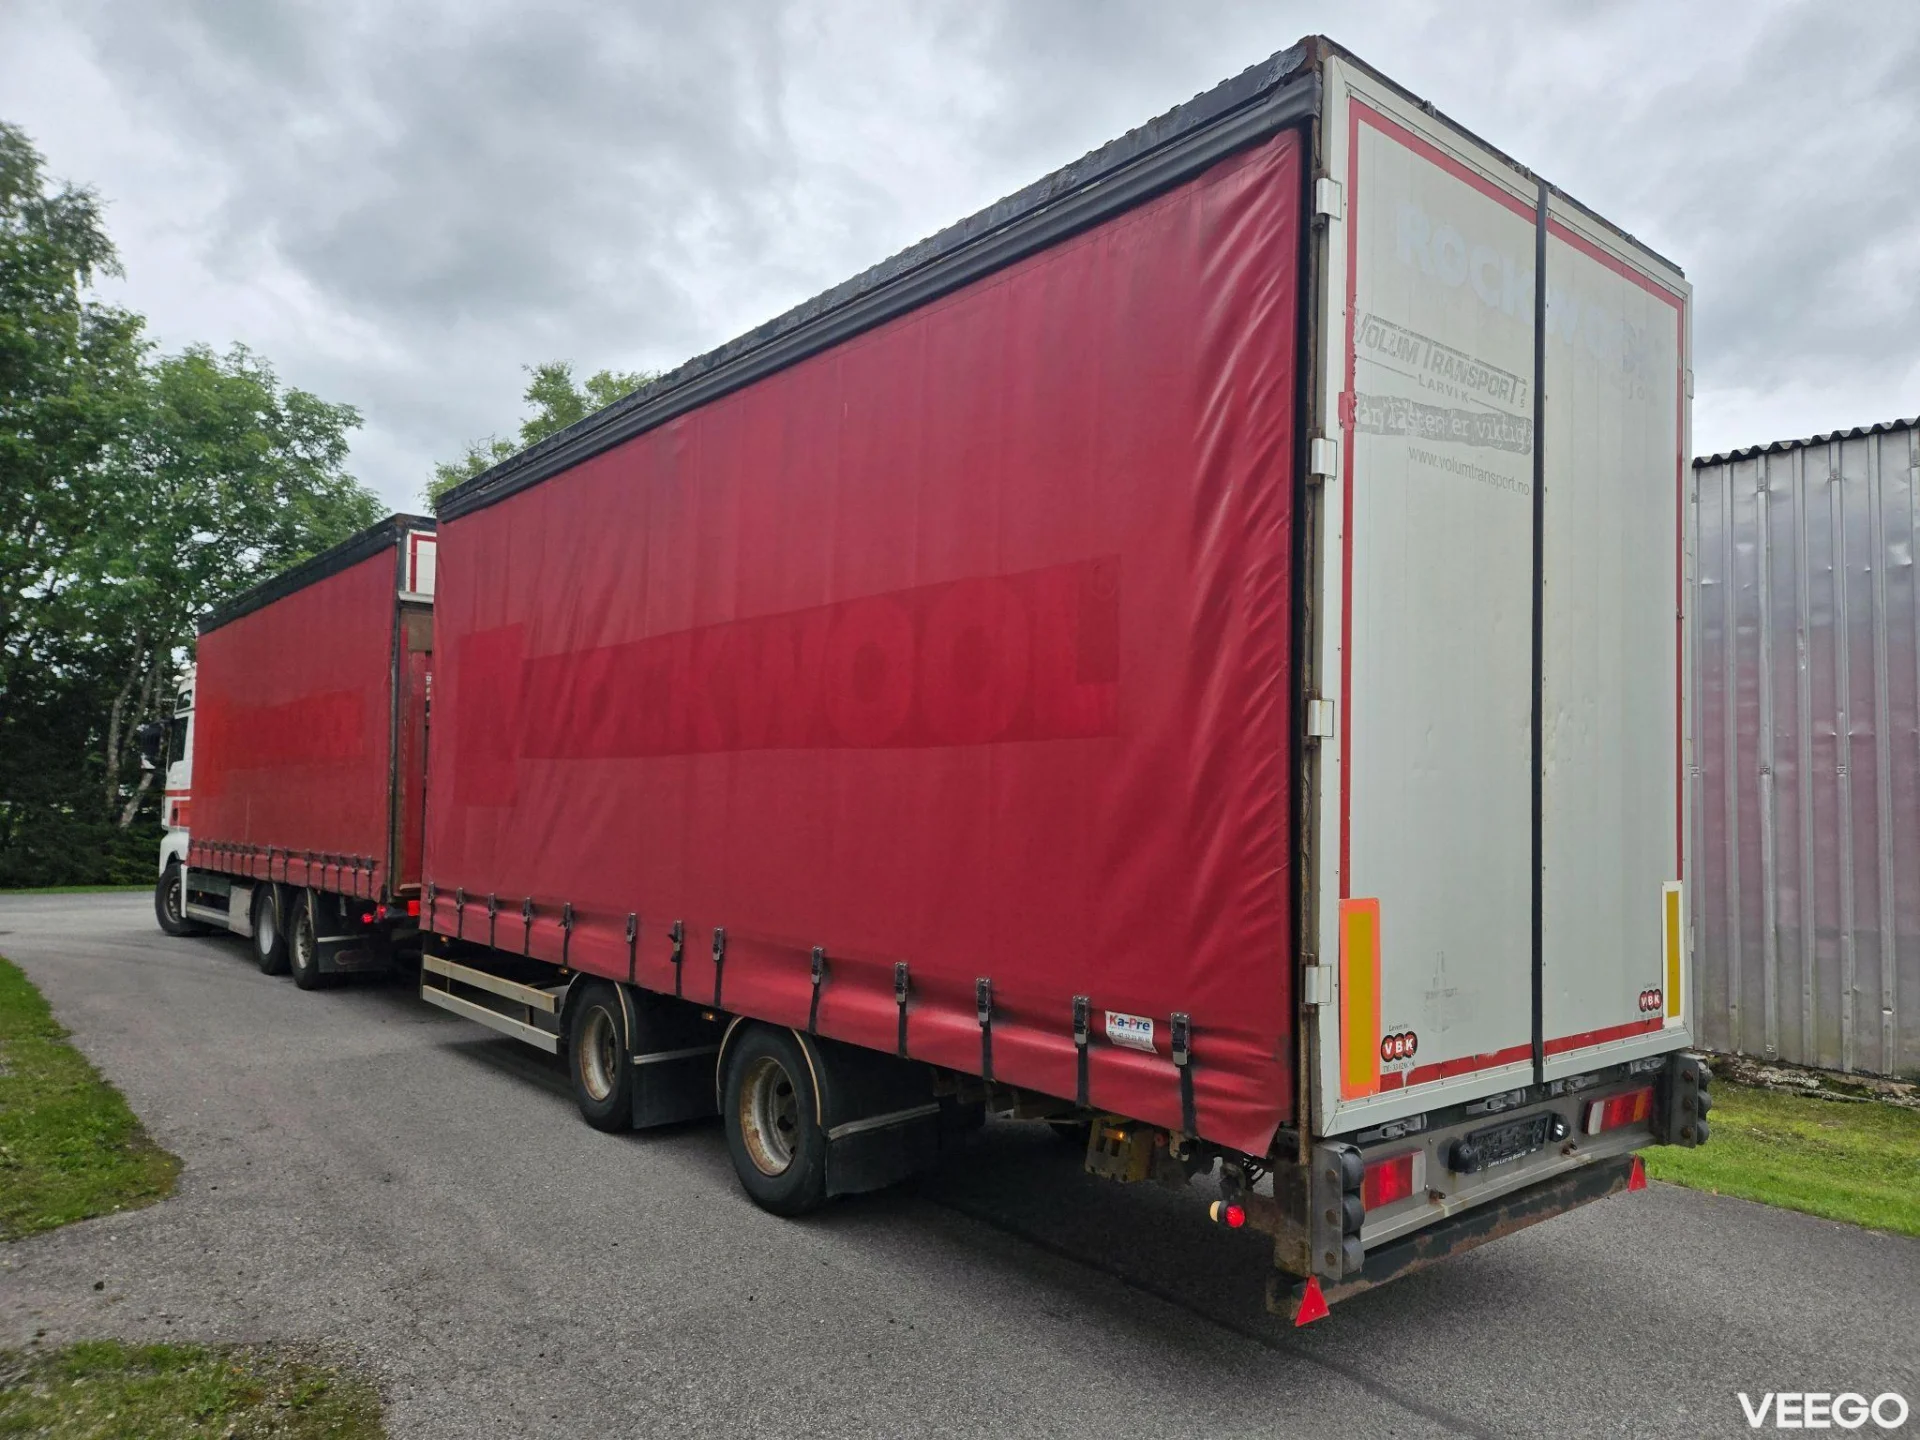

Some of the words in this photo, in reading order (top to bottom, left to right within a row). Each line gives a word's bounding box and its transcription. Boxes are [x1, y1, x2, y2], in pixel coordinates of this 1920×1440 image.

[1418, 373, 1471, 404] LARVIK
[1408, 446, 1530, 496] www.volumtransport.no
[1109, 1014, 1151, 1031] Ka-Pre
[1384, 1037, 1415, 1056] VBK
